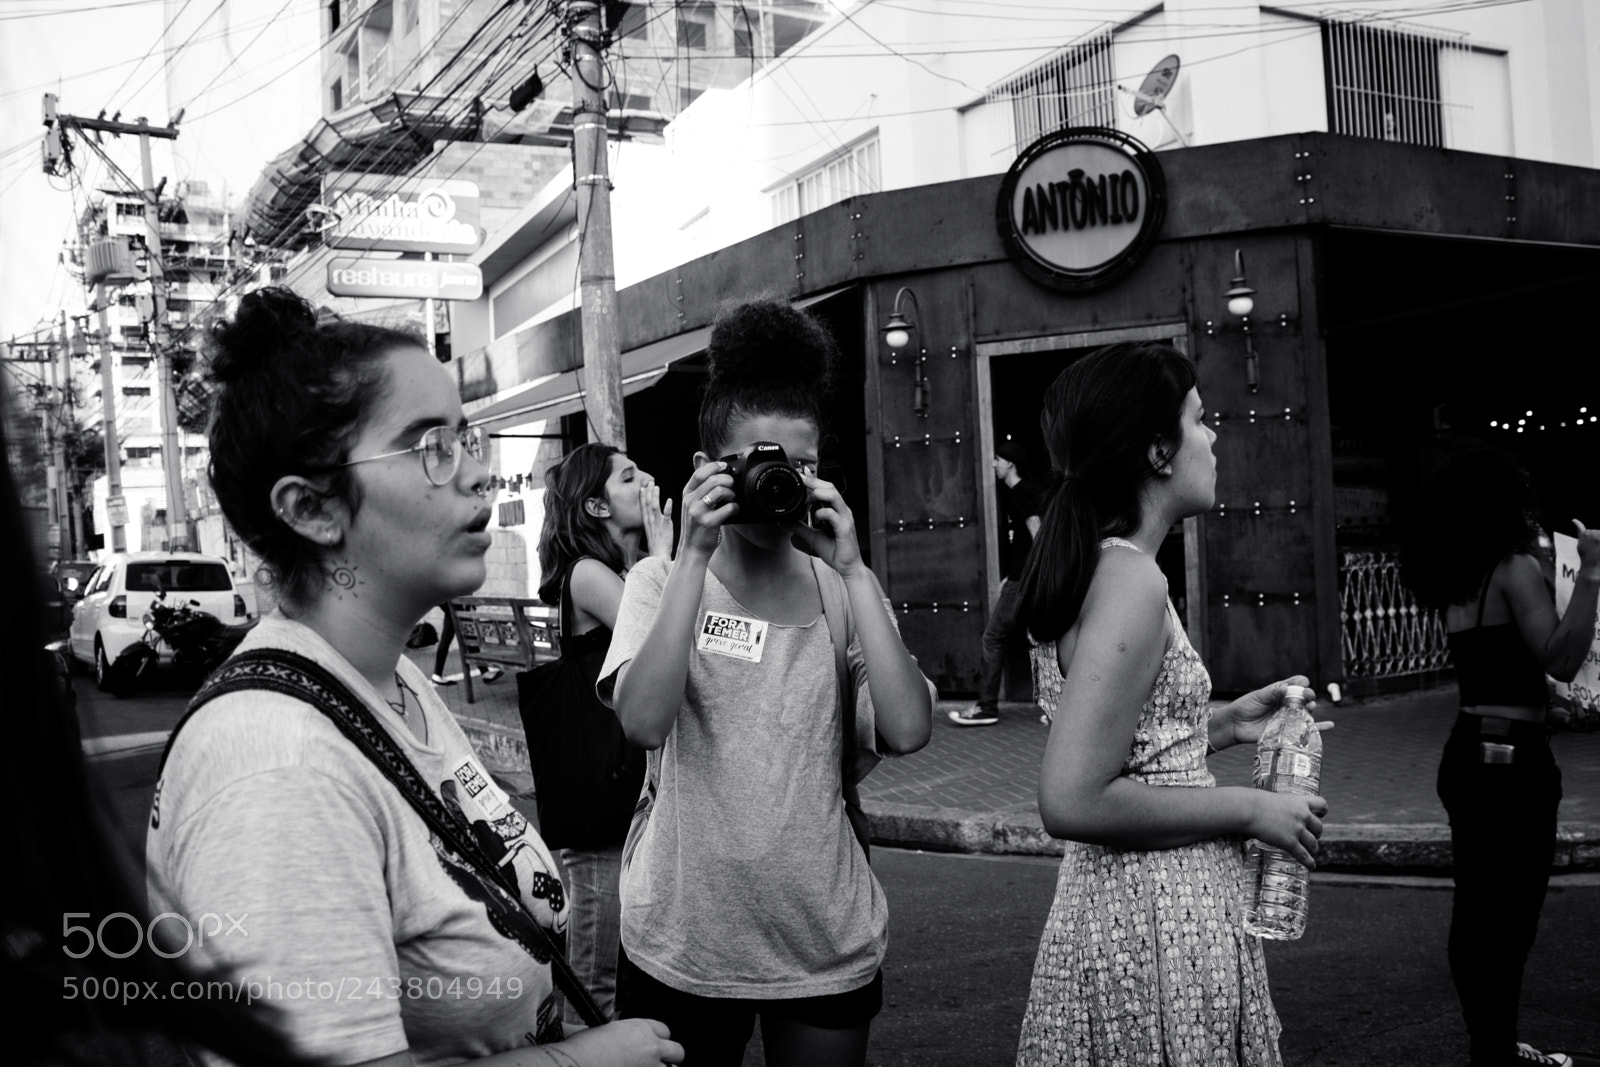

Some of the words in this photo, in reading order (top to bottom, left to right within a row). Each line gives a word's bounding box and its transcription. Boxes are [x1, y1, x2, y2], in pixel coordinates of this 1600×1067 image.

[707, 624, 748, 642] TEMER
[710, 616, 746, 632] FORA
[465, 773, 487, 797] TEME
